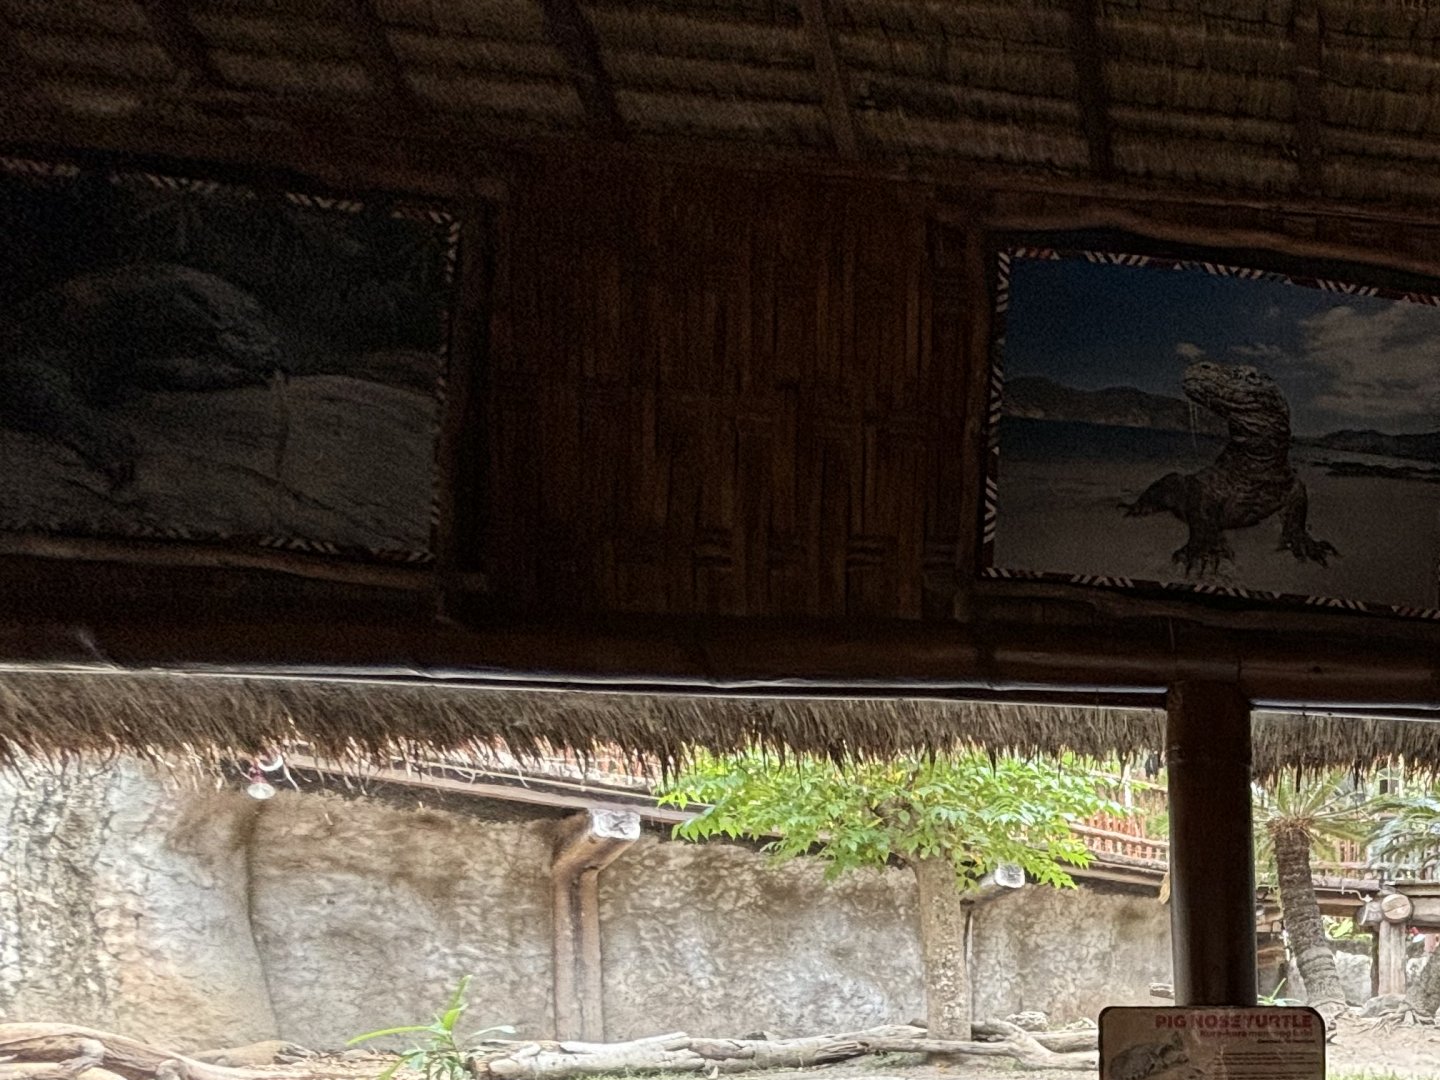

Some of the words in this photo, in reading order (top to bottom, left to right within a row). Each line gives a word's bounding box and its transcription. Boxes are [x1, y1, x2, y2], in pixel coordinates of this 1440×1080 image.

[1154, 1014, 1188, 1028] PIG
[1190, 1014, 1241, 1028] NOSE
[1245, 1014, 1313, 1028] TURTLE
